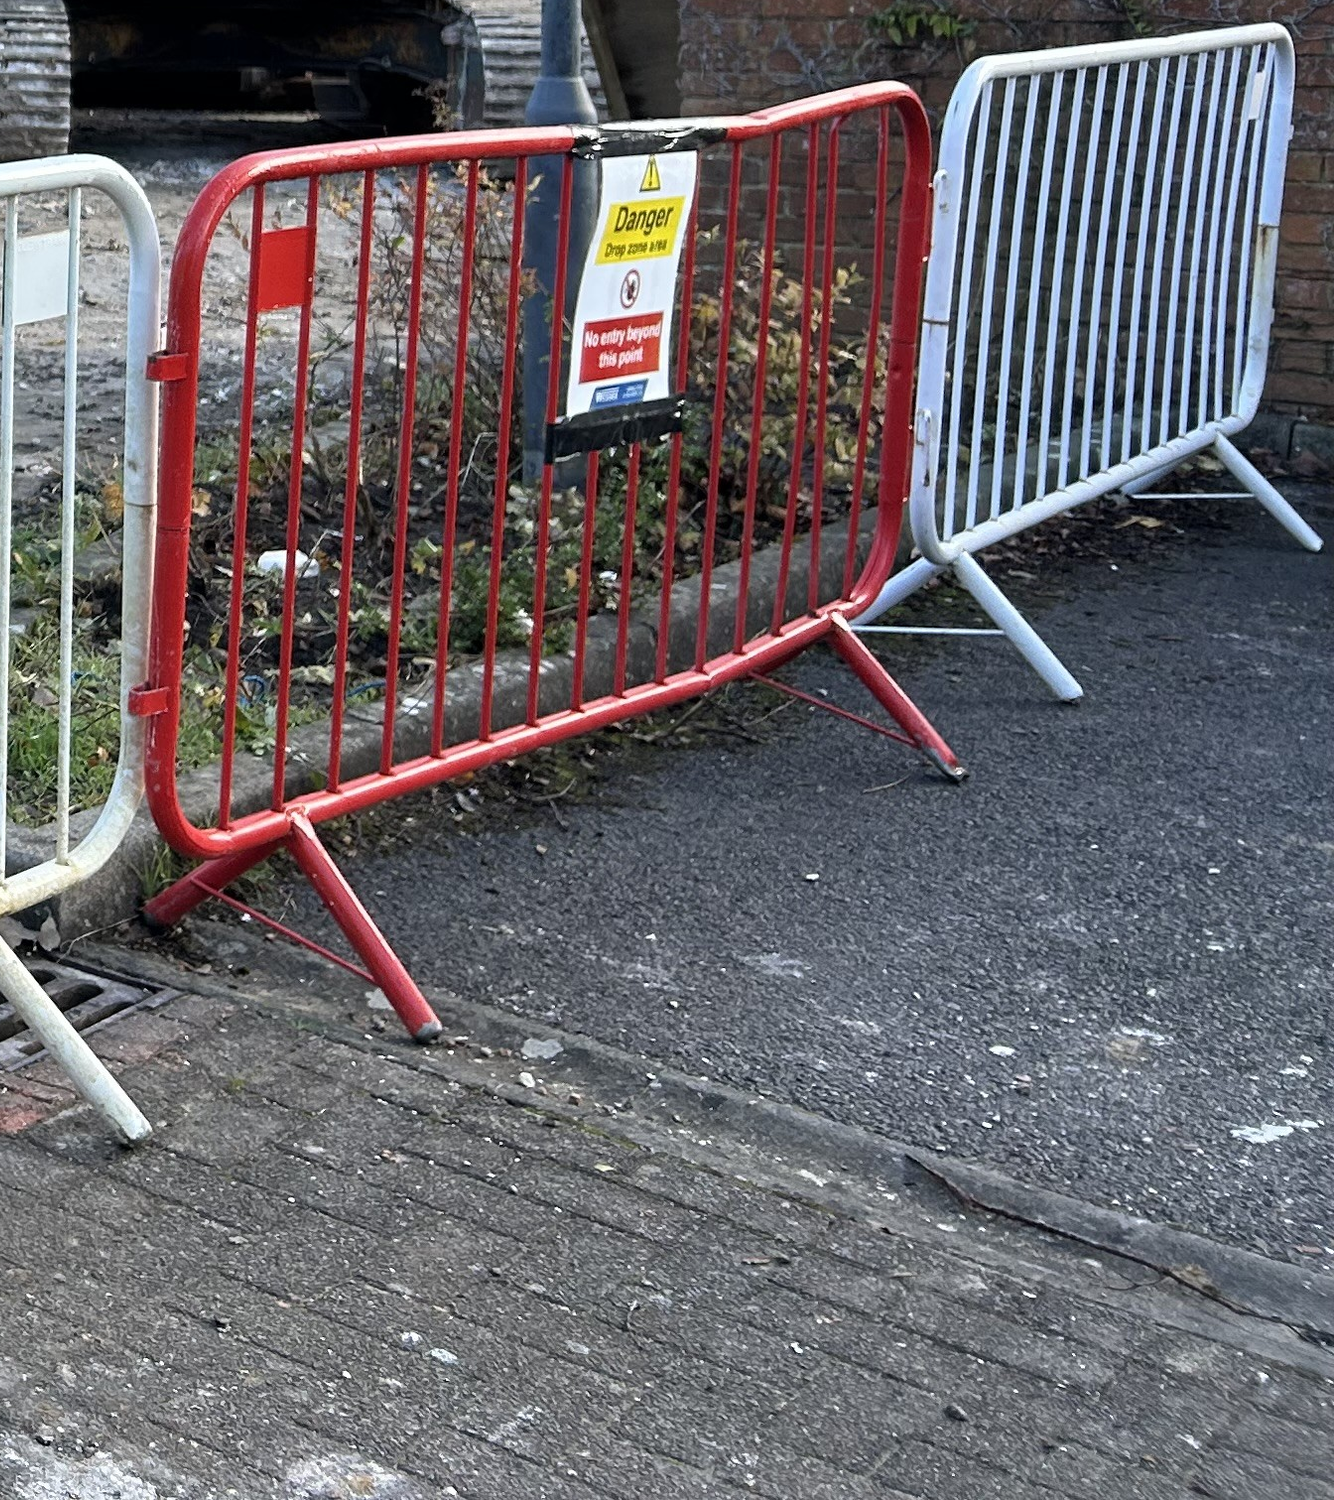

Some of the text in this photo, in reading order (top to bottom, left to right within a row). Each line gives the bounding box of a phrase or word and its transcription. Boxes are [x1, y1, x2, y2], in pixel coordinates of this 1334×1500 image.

[613, 205, 674, 236] Danger
[604, 239, 668, 260] Drop zone area
[584, 321, 661, 348] No entry beyond
[599, 345, 644, 369] this point
